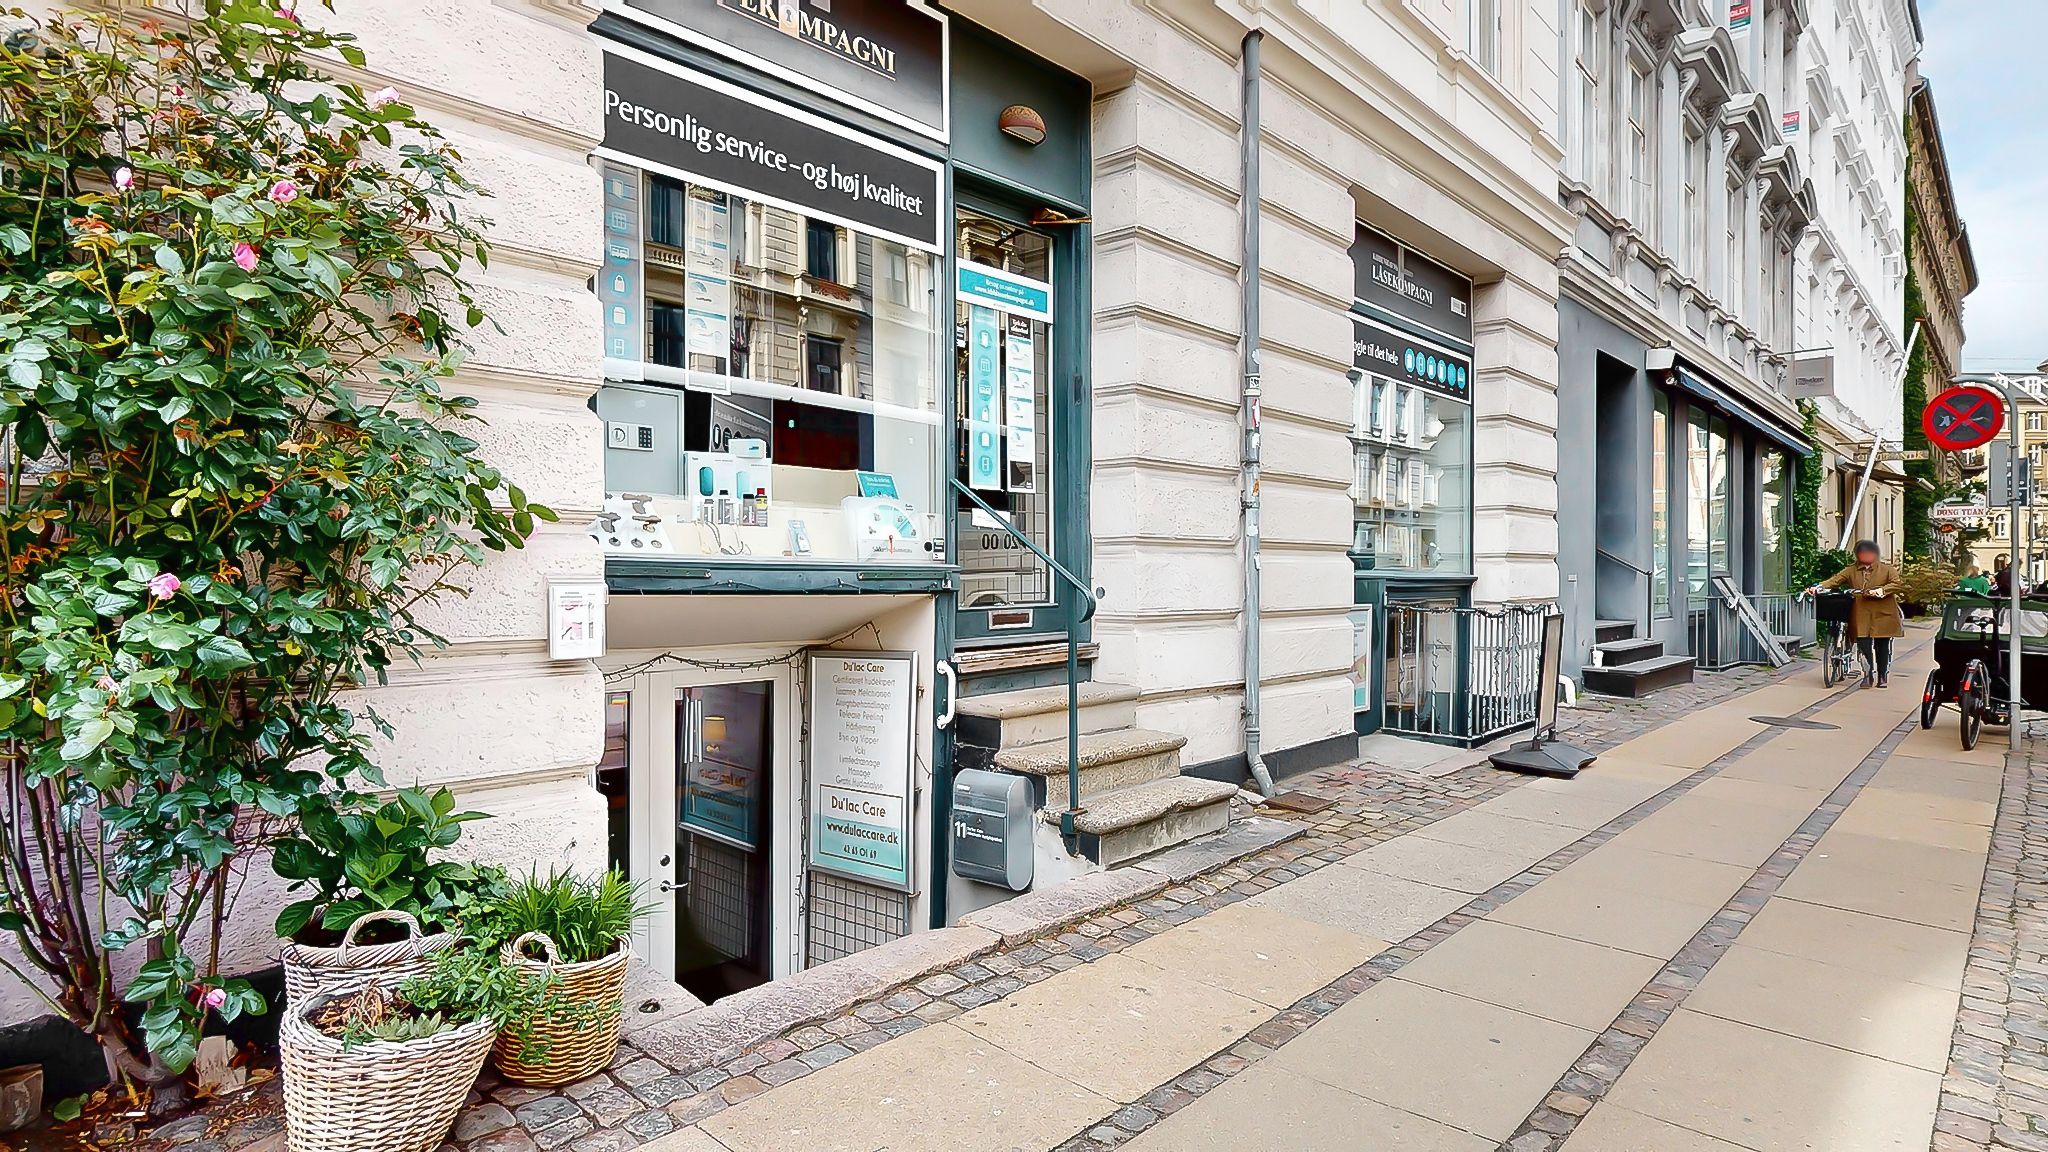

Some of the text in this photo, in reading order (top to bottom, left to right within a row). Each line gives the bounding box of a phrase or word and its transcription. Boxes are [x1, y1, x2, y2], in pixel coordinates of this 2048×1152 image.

[605, 89, 712, 153] Personlig
[715, 132, 787, 172] service
[802, 162, 828, 190] og
[831, 163, 859, 201] høj
[863, 174, 923, 216] kvalitet
[1375, 345, 1386, 361] det
[1386, 347, 1399, 366] hele
[1936, 508, 1984, 516] DONG YUAN
[866, 662, 885, 673] Care
[862, 801, 886, 818] Care
[954, 820, 967, 839] 11
